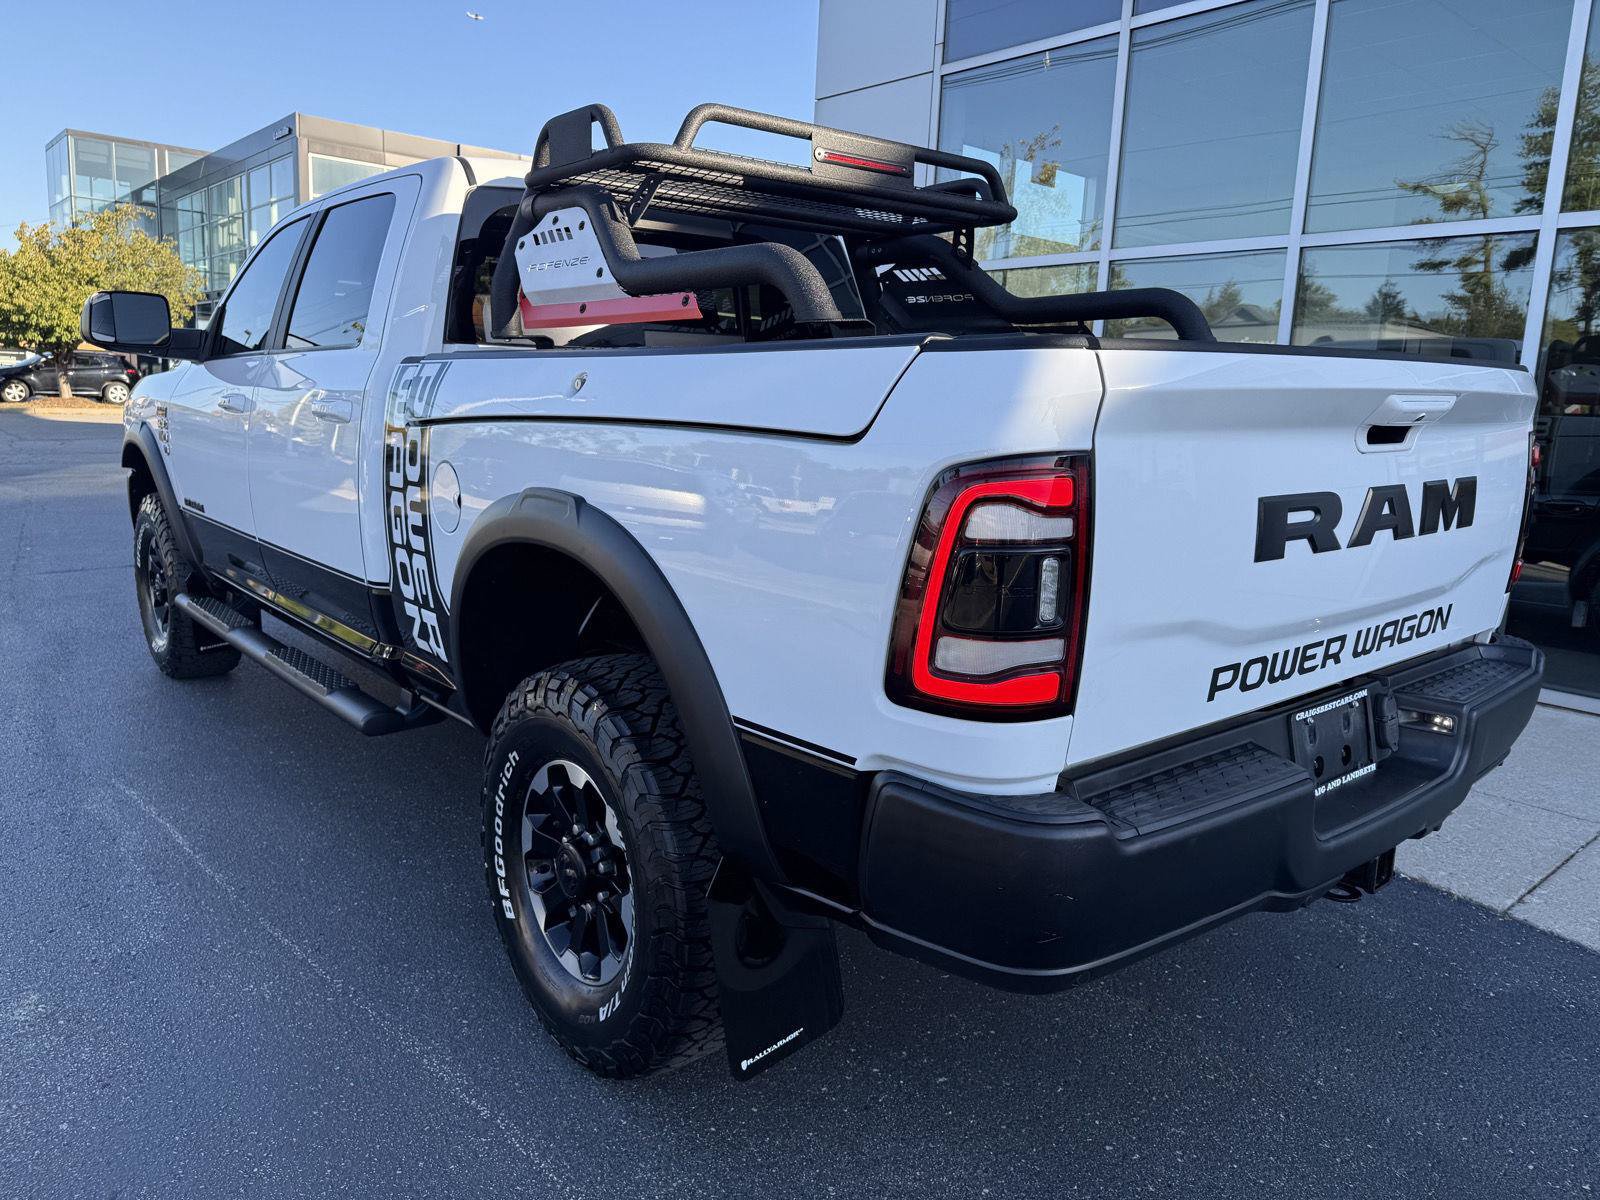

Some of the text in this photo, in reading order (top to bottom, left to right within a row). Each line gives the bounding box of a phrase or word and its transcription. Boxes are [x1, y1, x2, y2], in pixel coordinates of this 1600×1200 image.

[389, 363, 433, 654] WAGON
[407, 362, 449, 663] POWER
[1254, 476, 1478, 563] RAM
[1206, 603, 1453, 703] POWER WAGON
[1295, 689, 1369, 721] CRAIGSBESTCARS.COM
[1327, 779, 1342, 792] AND
[1342, 763, 1377, 784] LANDRETH
